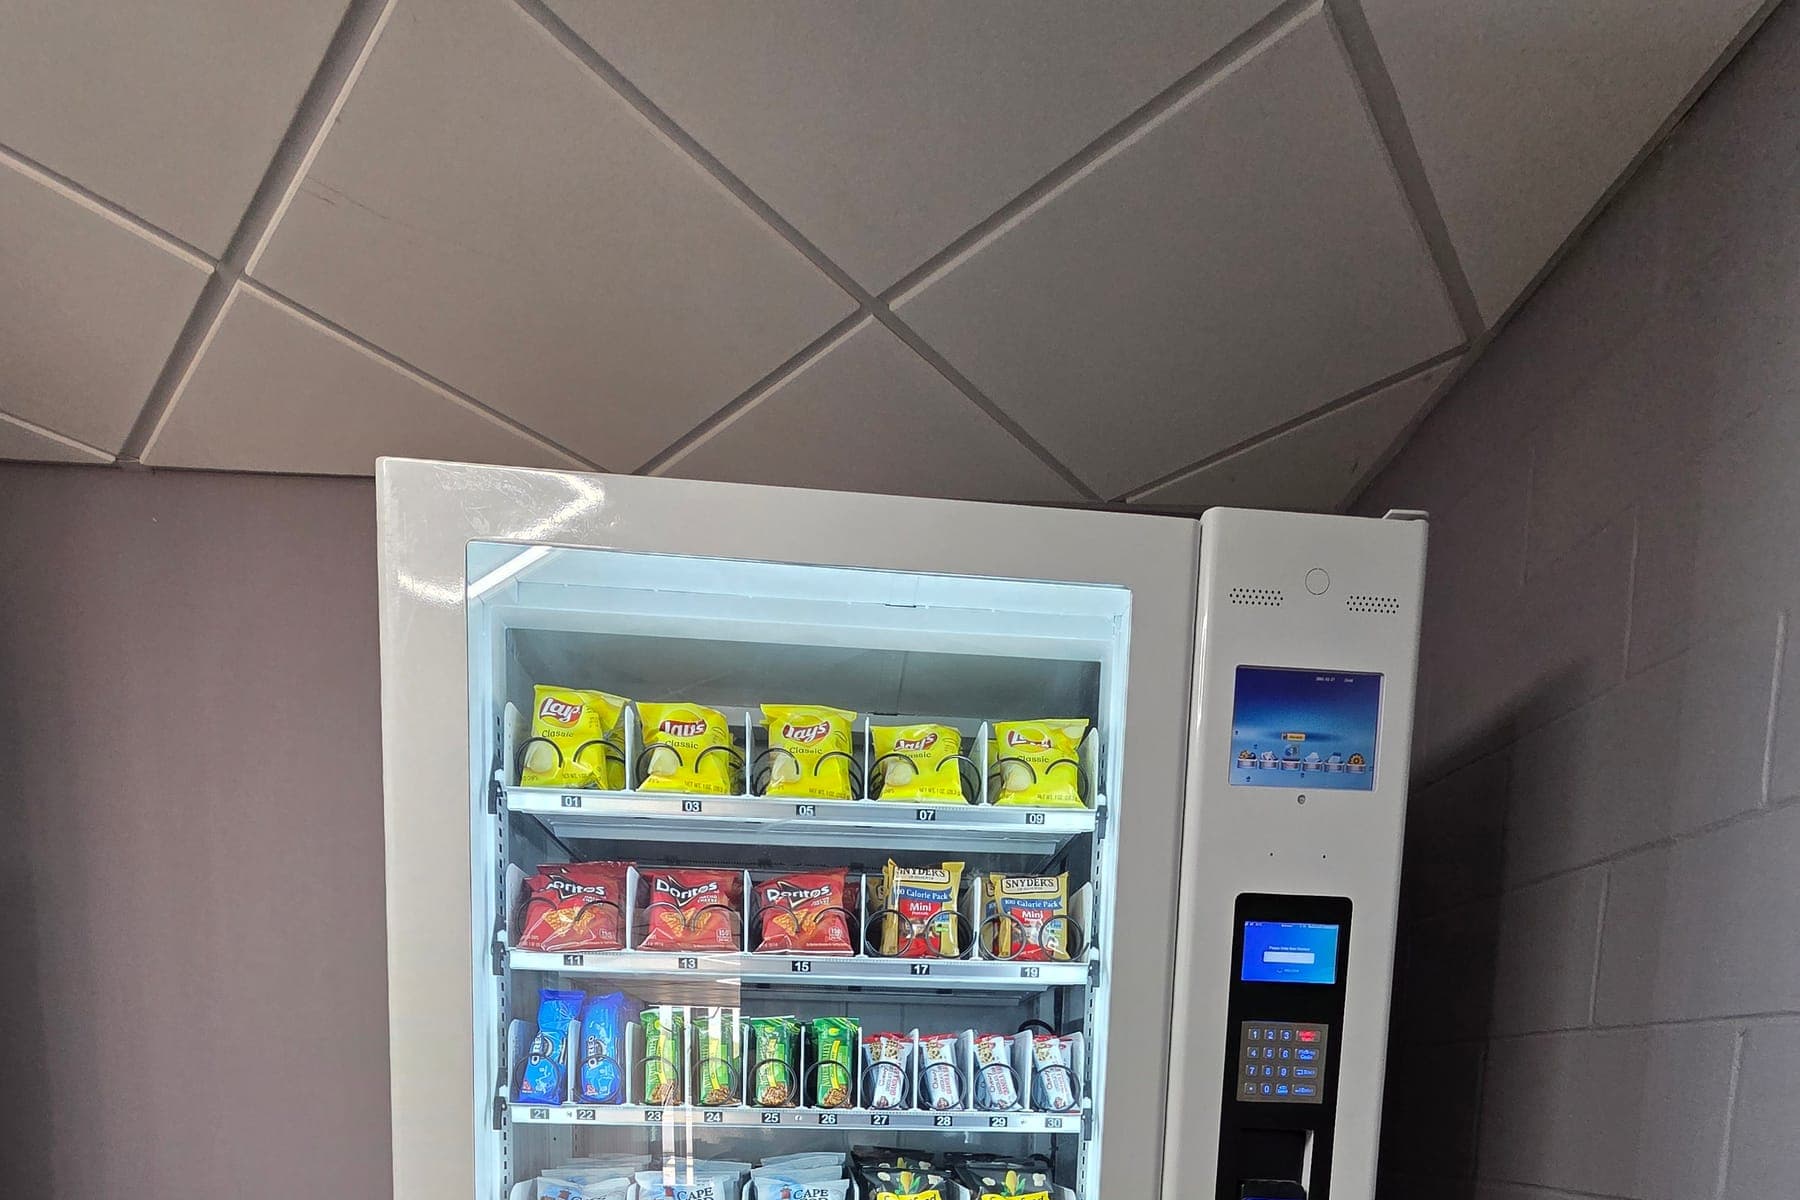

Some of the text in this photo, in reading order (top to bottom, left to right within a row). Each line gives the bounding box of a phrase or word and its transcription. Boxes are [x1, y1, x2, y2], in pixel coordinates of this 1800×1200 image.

[565, 796, 579, 807] 01
[685, 801, 700, 812] 03
[799, 805, 814, 816] 05
[919, 810, 934, 820] 07
[1029, 814, 1044, 824] 09
[656, 878, 718, 899] Doritos
[906, 888, 931, 900] Calorie
[932, 891, 948, 900] Pack
[909, 902, 932, 912] Mini
[1016, 899, 1043, 908] Calorie
[1021, 910, 1044, 919] Mini
[567, 955, 581, 965] 11
[681, 958, 697, 968] 13
[794, 961, 810, 972] 15
[913, 965, 929, 975] 17
[1024, 968, 1039, 978] 19
[534, 1109, 548, 1119] 21
[579, 1109, 593, 1119] 22
[647, 1111, 662, 1121] 23
[706, 1112, 720, 1122] 24
[764, 1113, 779, 1123] 25
[821, 1114, 836, 1124] 26
[873, 1116, 888, 1125] 27
[936, 1116, 951, 1126] 28
[992, 1117, 1006, 1127] 29
[1047, 1119, 1061, 1128] 30
[793, 1189, 829, 1200] CAPE
